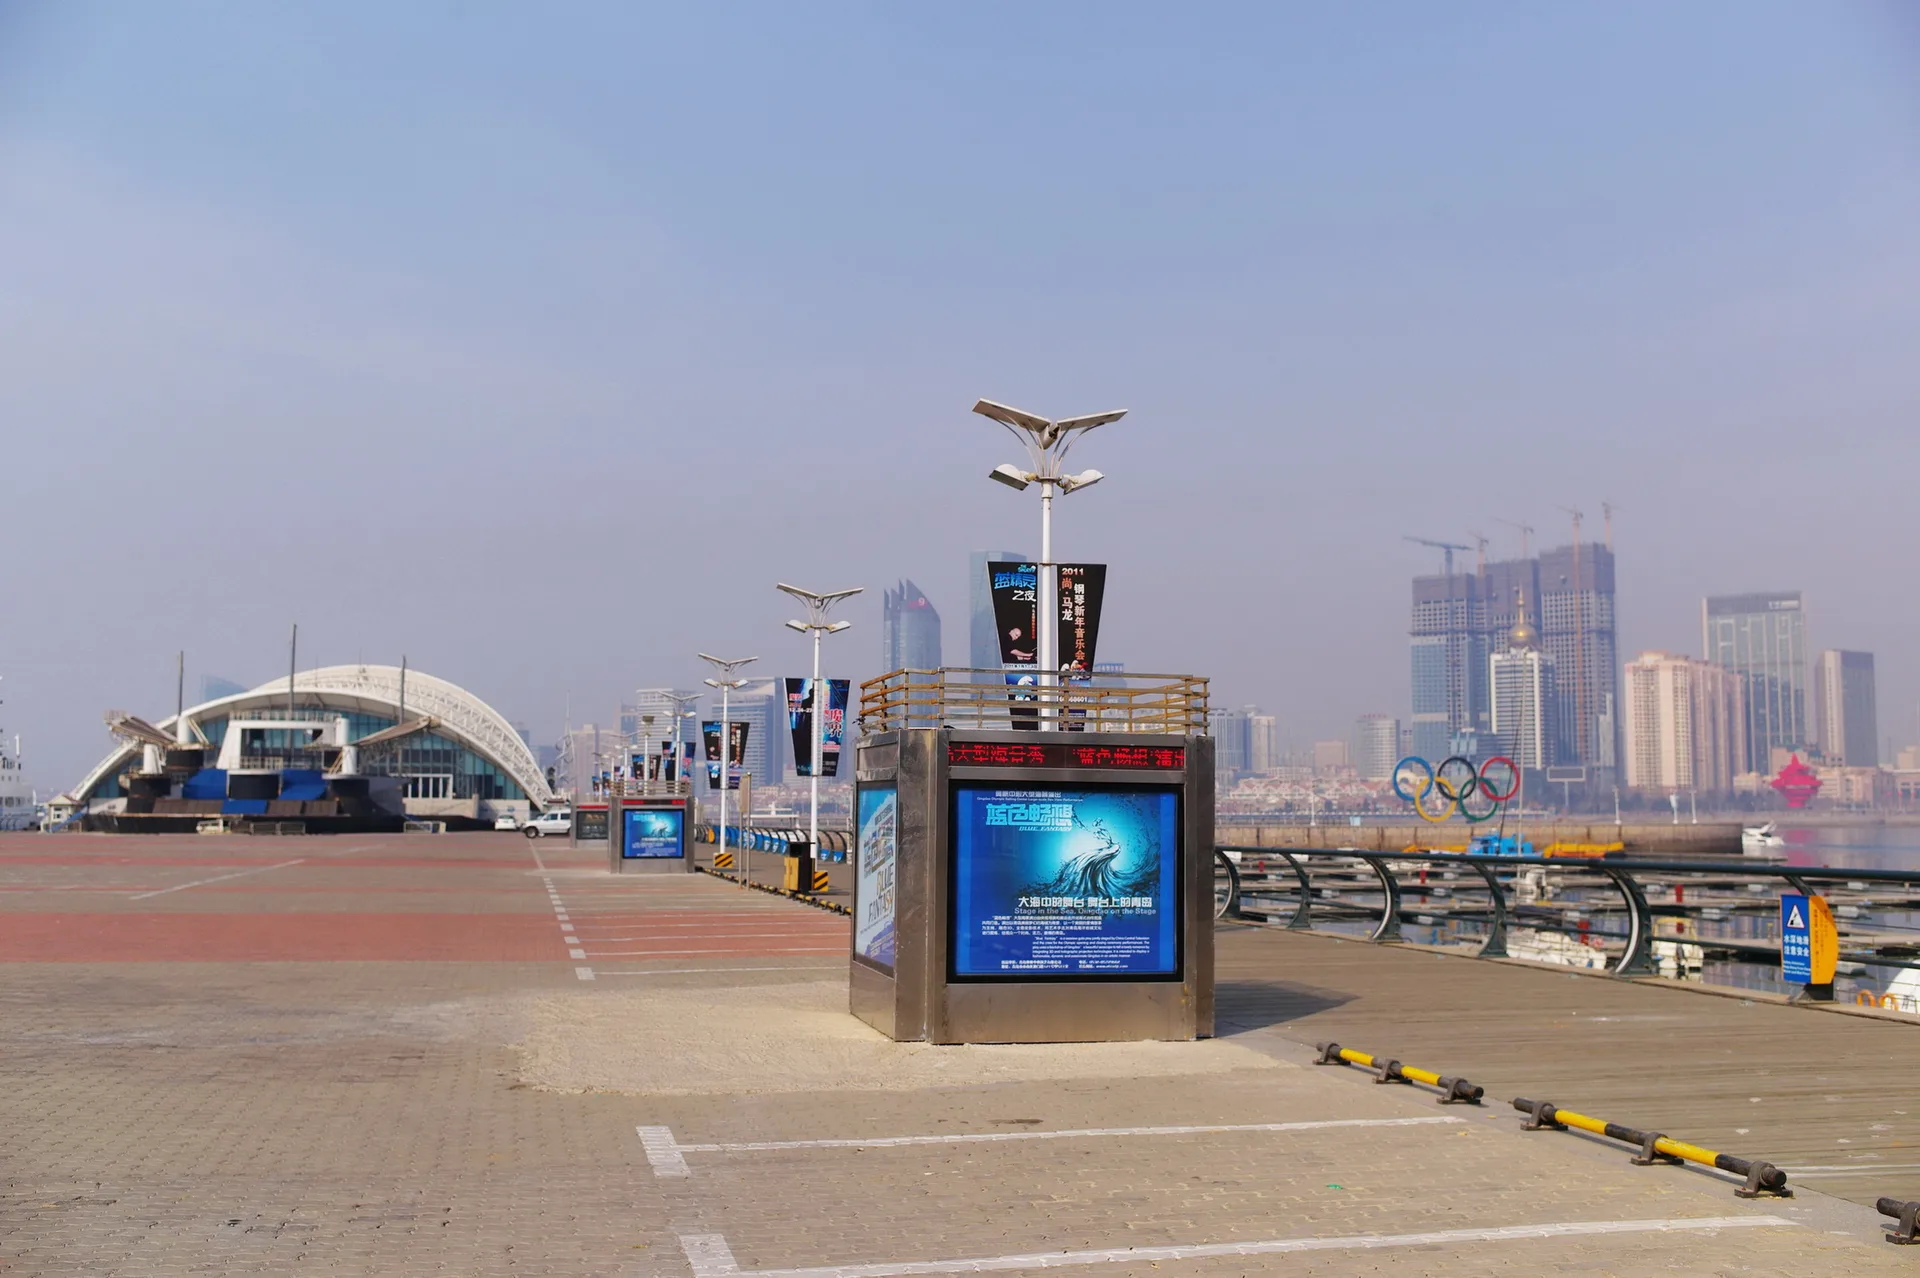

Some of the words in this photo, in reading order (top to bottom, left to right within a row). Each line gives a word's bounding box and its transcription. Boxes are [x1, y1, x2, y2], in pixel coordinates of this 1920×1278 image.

[1062, 568, 1084, 576] 2011
[994, 572, 1036, 590] 蓝精灵
[1012, 590, 1036, 602] 之夜
[1074, 583, 1086, 660] 钢琴新年音乐会
[986, 804, 1072, 826] 蓝色畅想
[1018, 896, 1084, 908] 大海中的舞台
[1088, 897, 1152, 908] 舞台上的青岛
[1135, 908, 1156, 916] Stage
[1784, 946, 1809, 957] 注意安全
